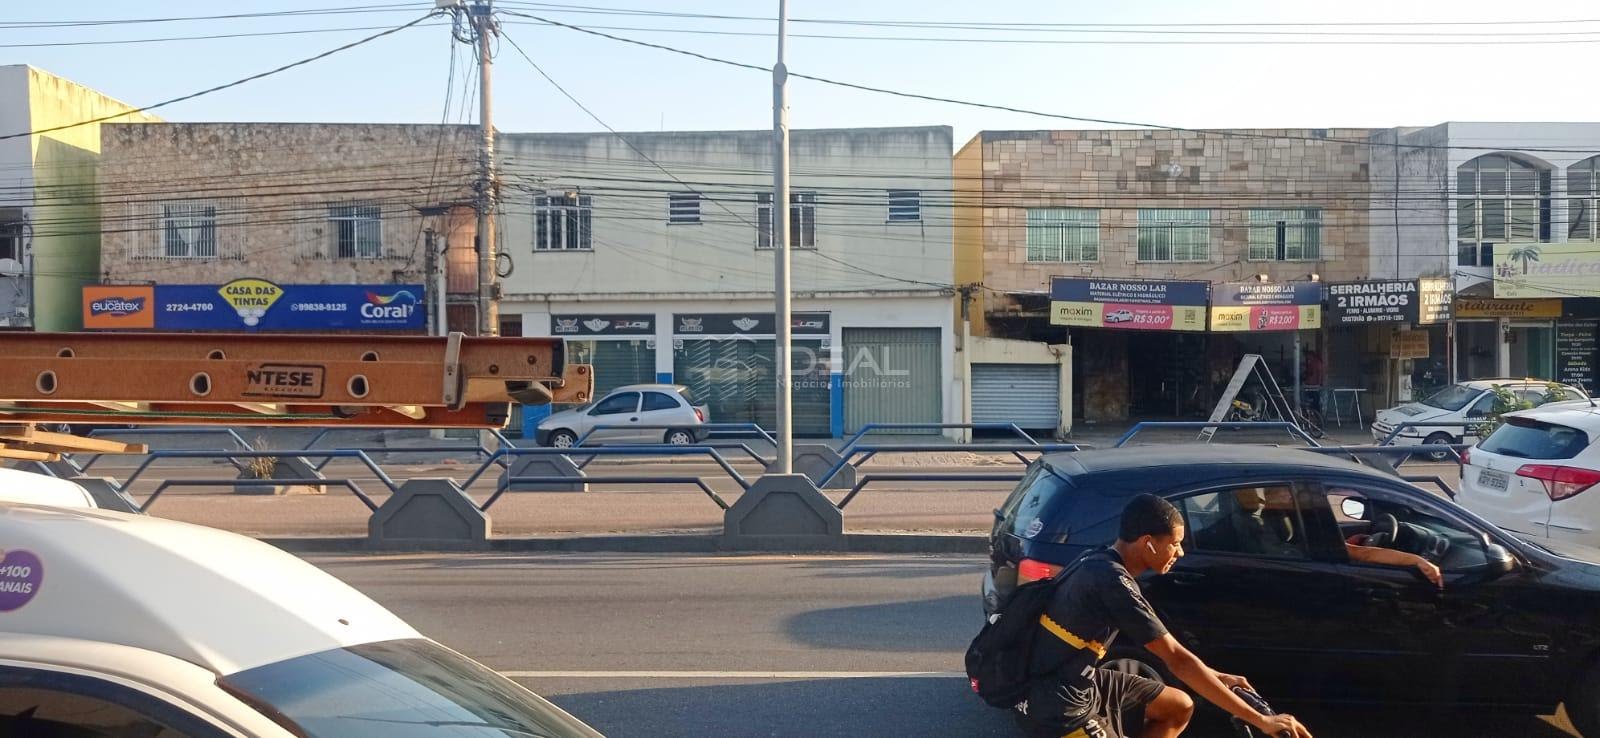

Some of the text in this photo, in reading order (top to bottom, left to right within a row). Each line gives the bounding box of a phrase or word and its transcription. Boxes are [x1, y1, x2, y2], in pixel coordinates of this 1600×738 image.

[226, 287, 276, 295] CASA DAS
[1089, 282, 1118, 291] BAZAR
[1120, 284, 1148, 292] NOSSO
[1240, 285, 1260, 293] BAZAR
[1262, 285, 1281, 293] NOSSO
[1330, 282, 1416, 295] SERRALHERIA
[233, 298, 269, 306] TINTAS
[1338, 293, 1409, 307] 2 IRMÃOS
[1424, 291, 1452, 305] 2 IRMÃOS
[92, 300, 140, 312] eucatex
[360, 303, 408, 318] Coral
[1060, 306, 1093, 316] maxim
[1133, 314, 1146, 323] R$
[1218, 312, 1243, 321] maxim
[1269, 315, 1278, 324] R$
[247, 370, 314, 387] NTESE
[0, 565, 32, 578] +100
